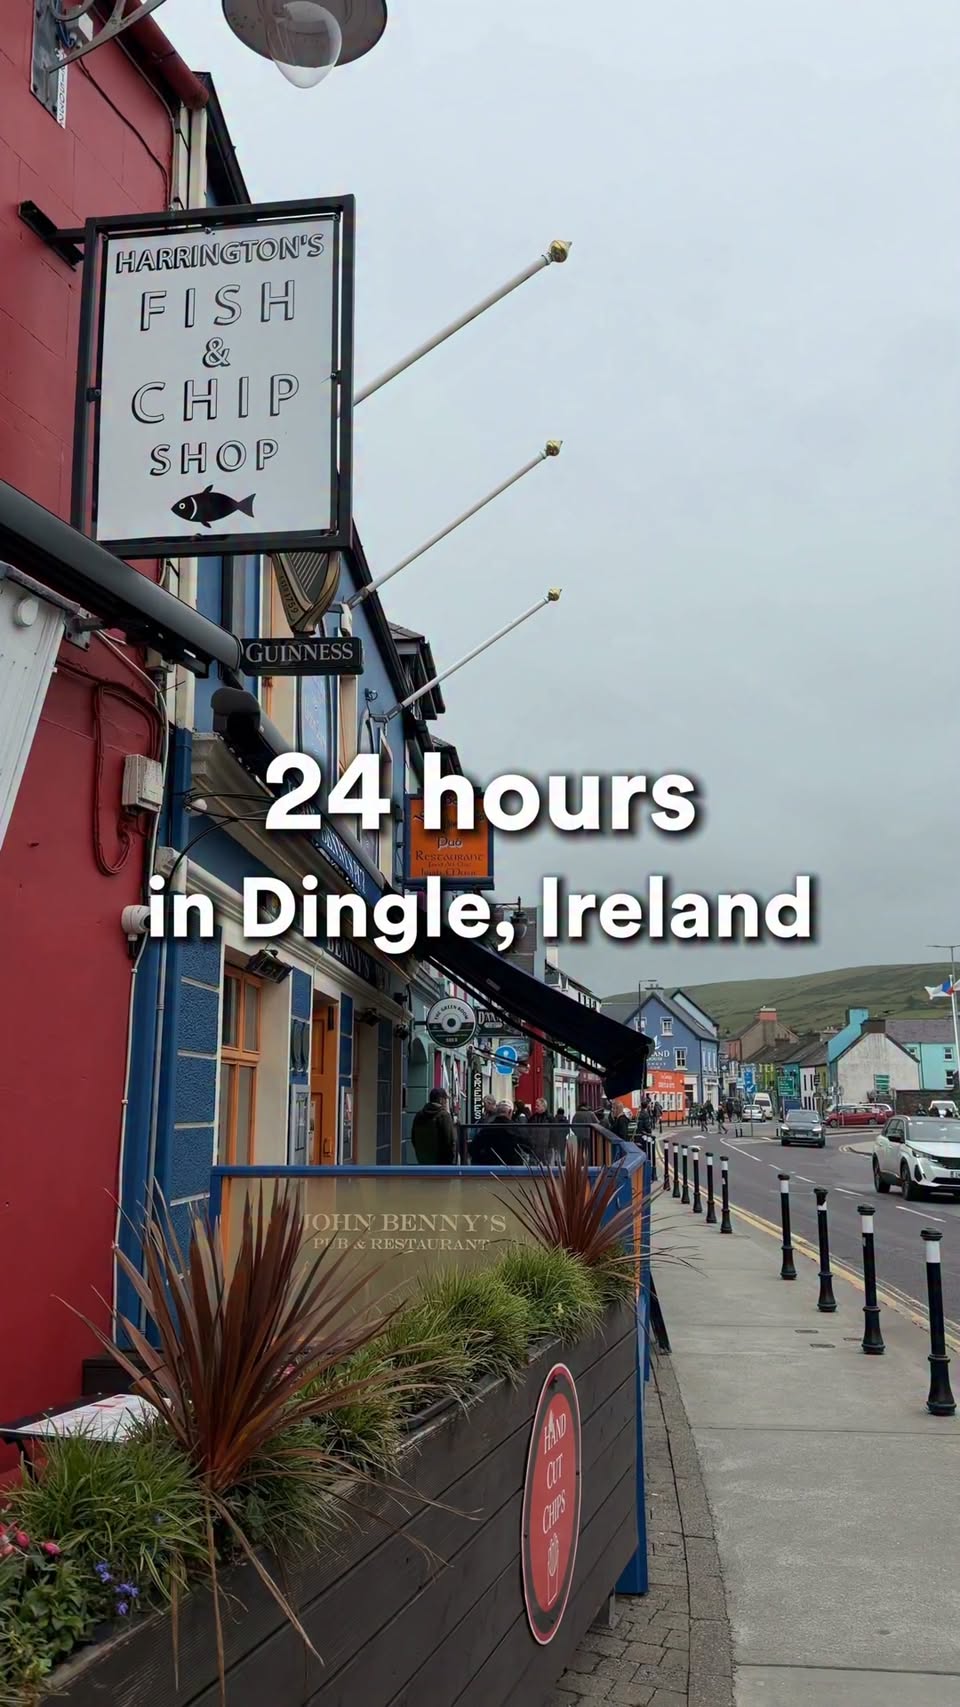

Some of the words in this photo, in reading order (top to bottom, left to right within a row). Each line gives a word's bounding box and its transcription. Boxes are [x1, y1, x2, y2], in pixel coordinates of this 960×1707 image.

[115, 233, 325, 274] HARRINGTON'S
[140, 280, 295, 331] FISH
[202, 337, 231, 368] &
[131, 374, 299, 424] CHIP
[150, 438, 279, 476] SHOP
[245, 642, 353, 663] GUINNESS
[441, 1004, 457, 1012] GREEN
[473, 1073, 482, 1120] CREPES
[303, 1213, 375, 1232] JOHN
[382, 1213, 507, 1233] BENNY'S
[313, 1238, 349, 1249] PUB
[353, 1239, 366, 1249] &
[370, 1238, 491, 1251] RESTAURANT
[543, 1410, 567, 1455] HAND
[546, 1453, 563, 1490] CUT
[542, 1489, 566, 1534] CHIPS
